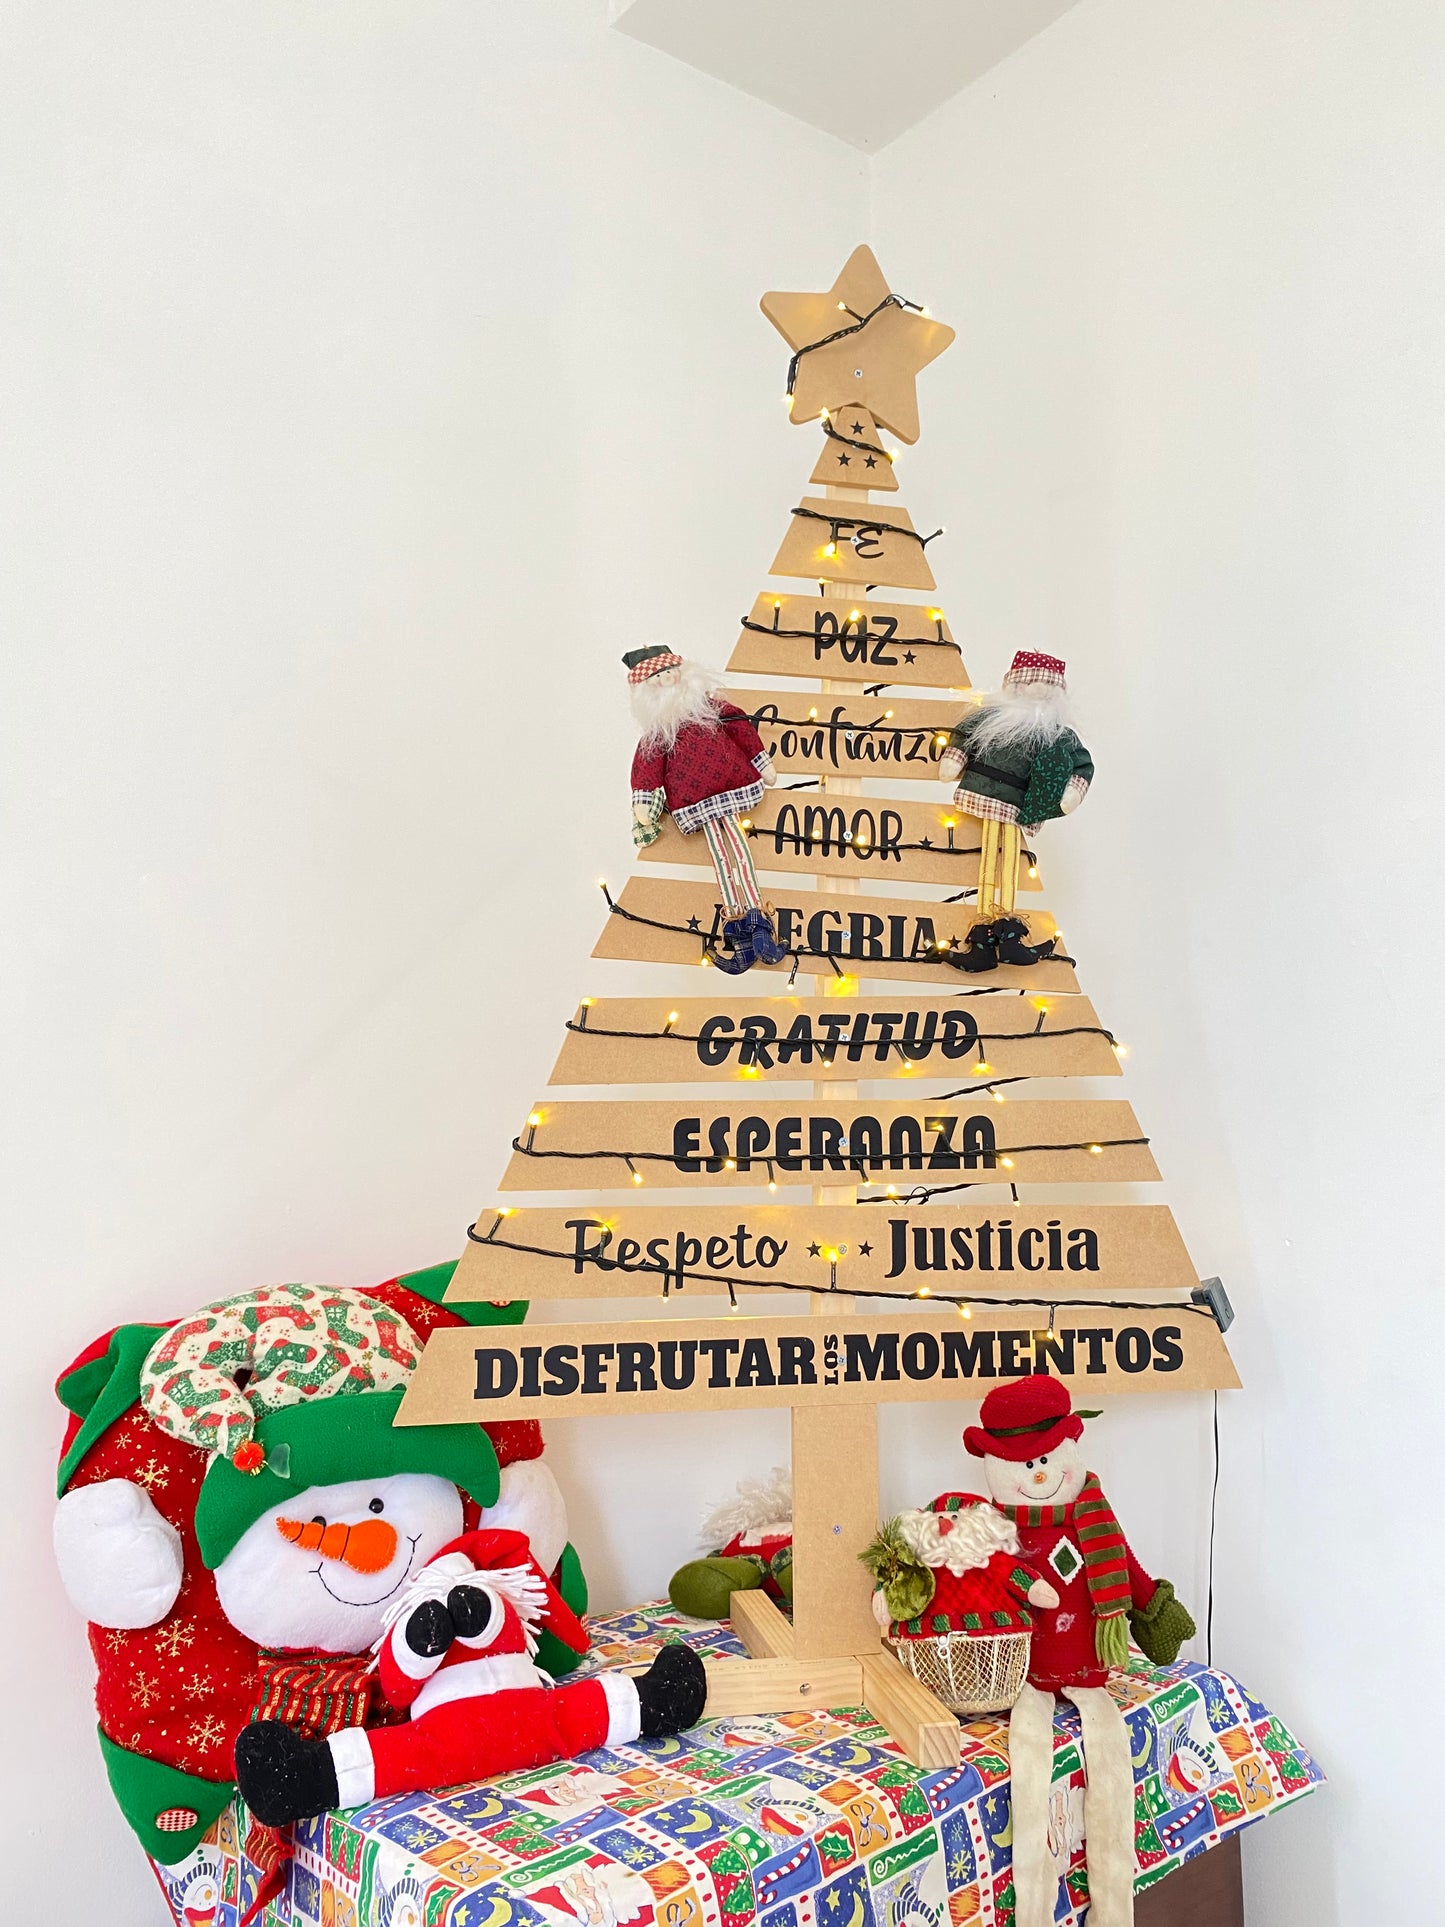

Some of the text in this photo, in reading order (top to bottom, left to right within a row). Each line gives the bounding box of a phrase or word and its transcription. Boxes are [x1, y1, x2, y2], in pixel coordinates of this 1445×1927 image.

[830, 520, 884, 559] FE
[775, 804, 903, 862] AMOR
[705, 904, 938, 960] AEGRIA
[697, 1010, 978, 1070] GRATITUD
[673, 1116, 996, 1173] ESPERANZA
[565, 1219, 1100, 1289] Respeto Justicia
[474, 1327, 1184, 1399] DISFRUTAR LOS MOMENTOS
